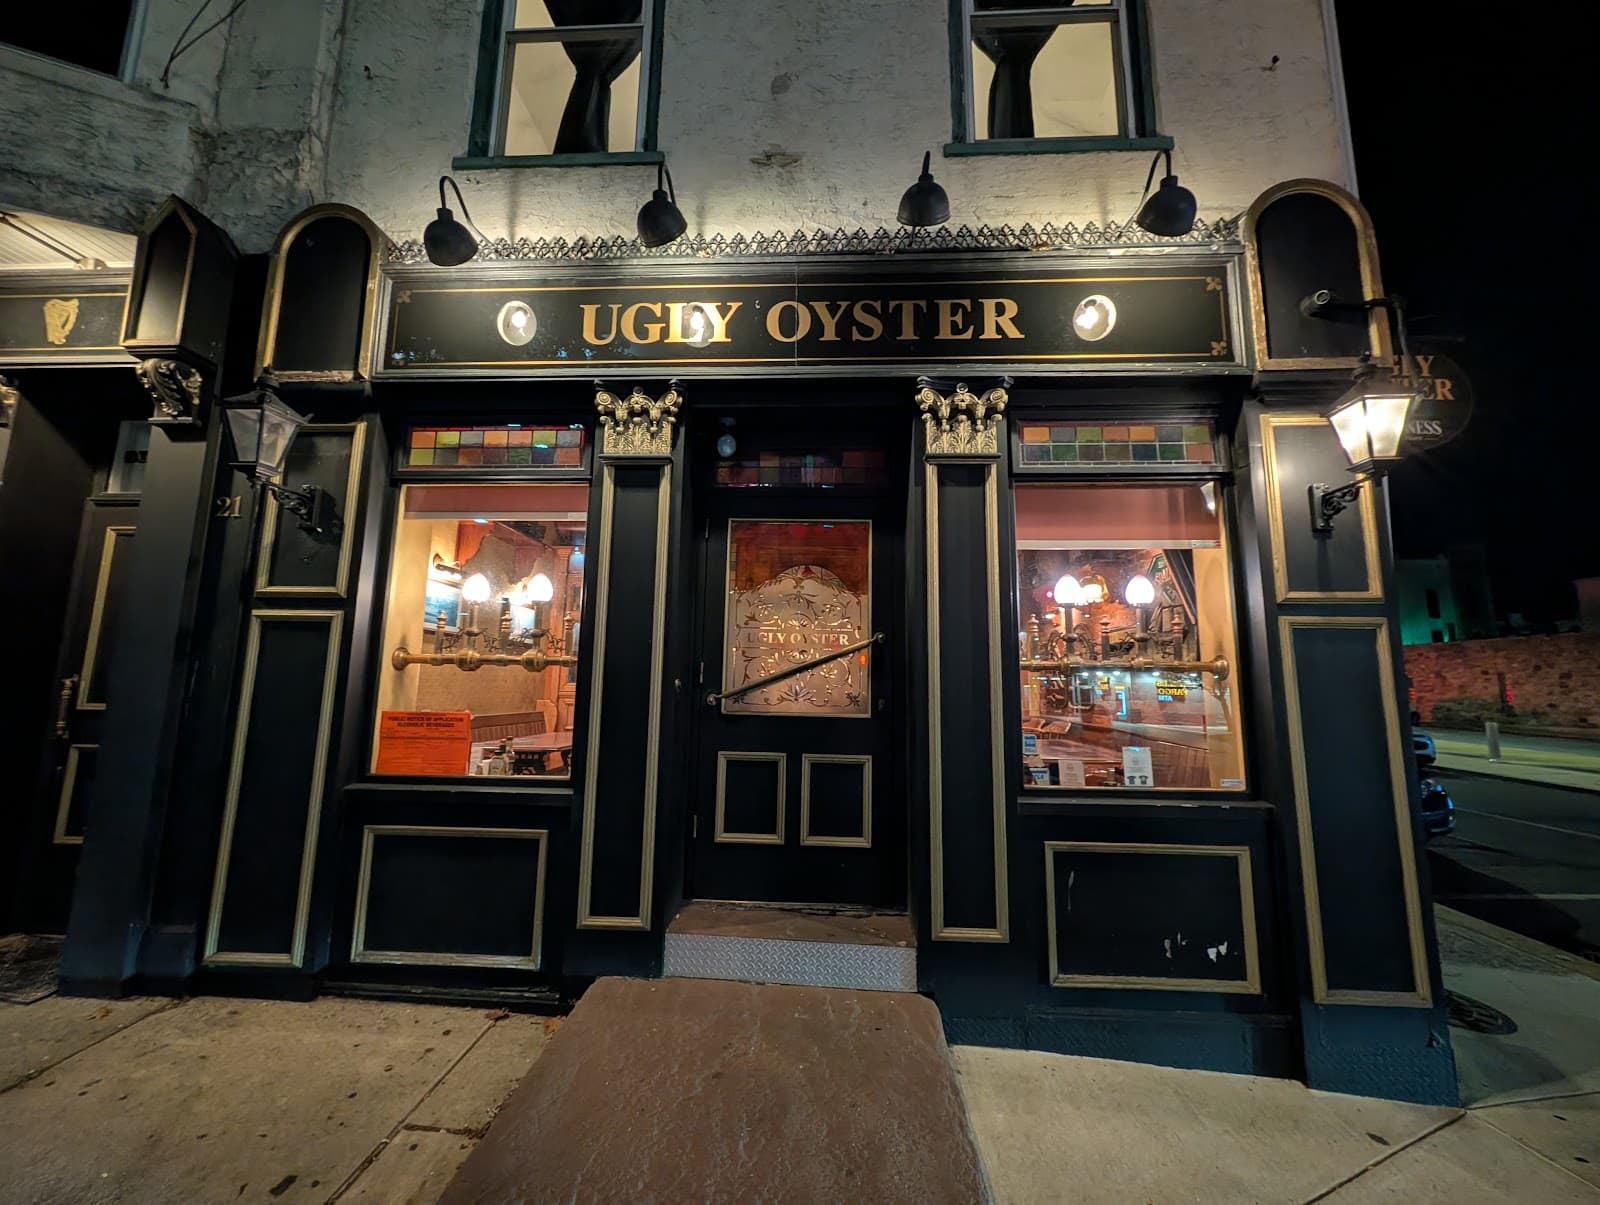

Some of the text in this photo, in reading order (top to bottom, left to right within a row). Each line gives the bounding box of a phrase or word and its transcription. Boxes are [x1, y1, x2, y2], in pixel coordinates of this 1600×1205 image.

[579, 298, 1026, 346] UGLY OYSTER
[216, 495, 243, 518] 21
[747, 631, 786, 644] UGLY
